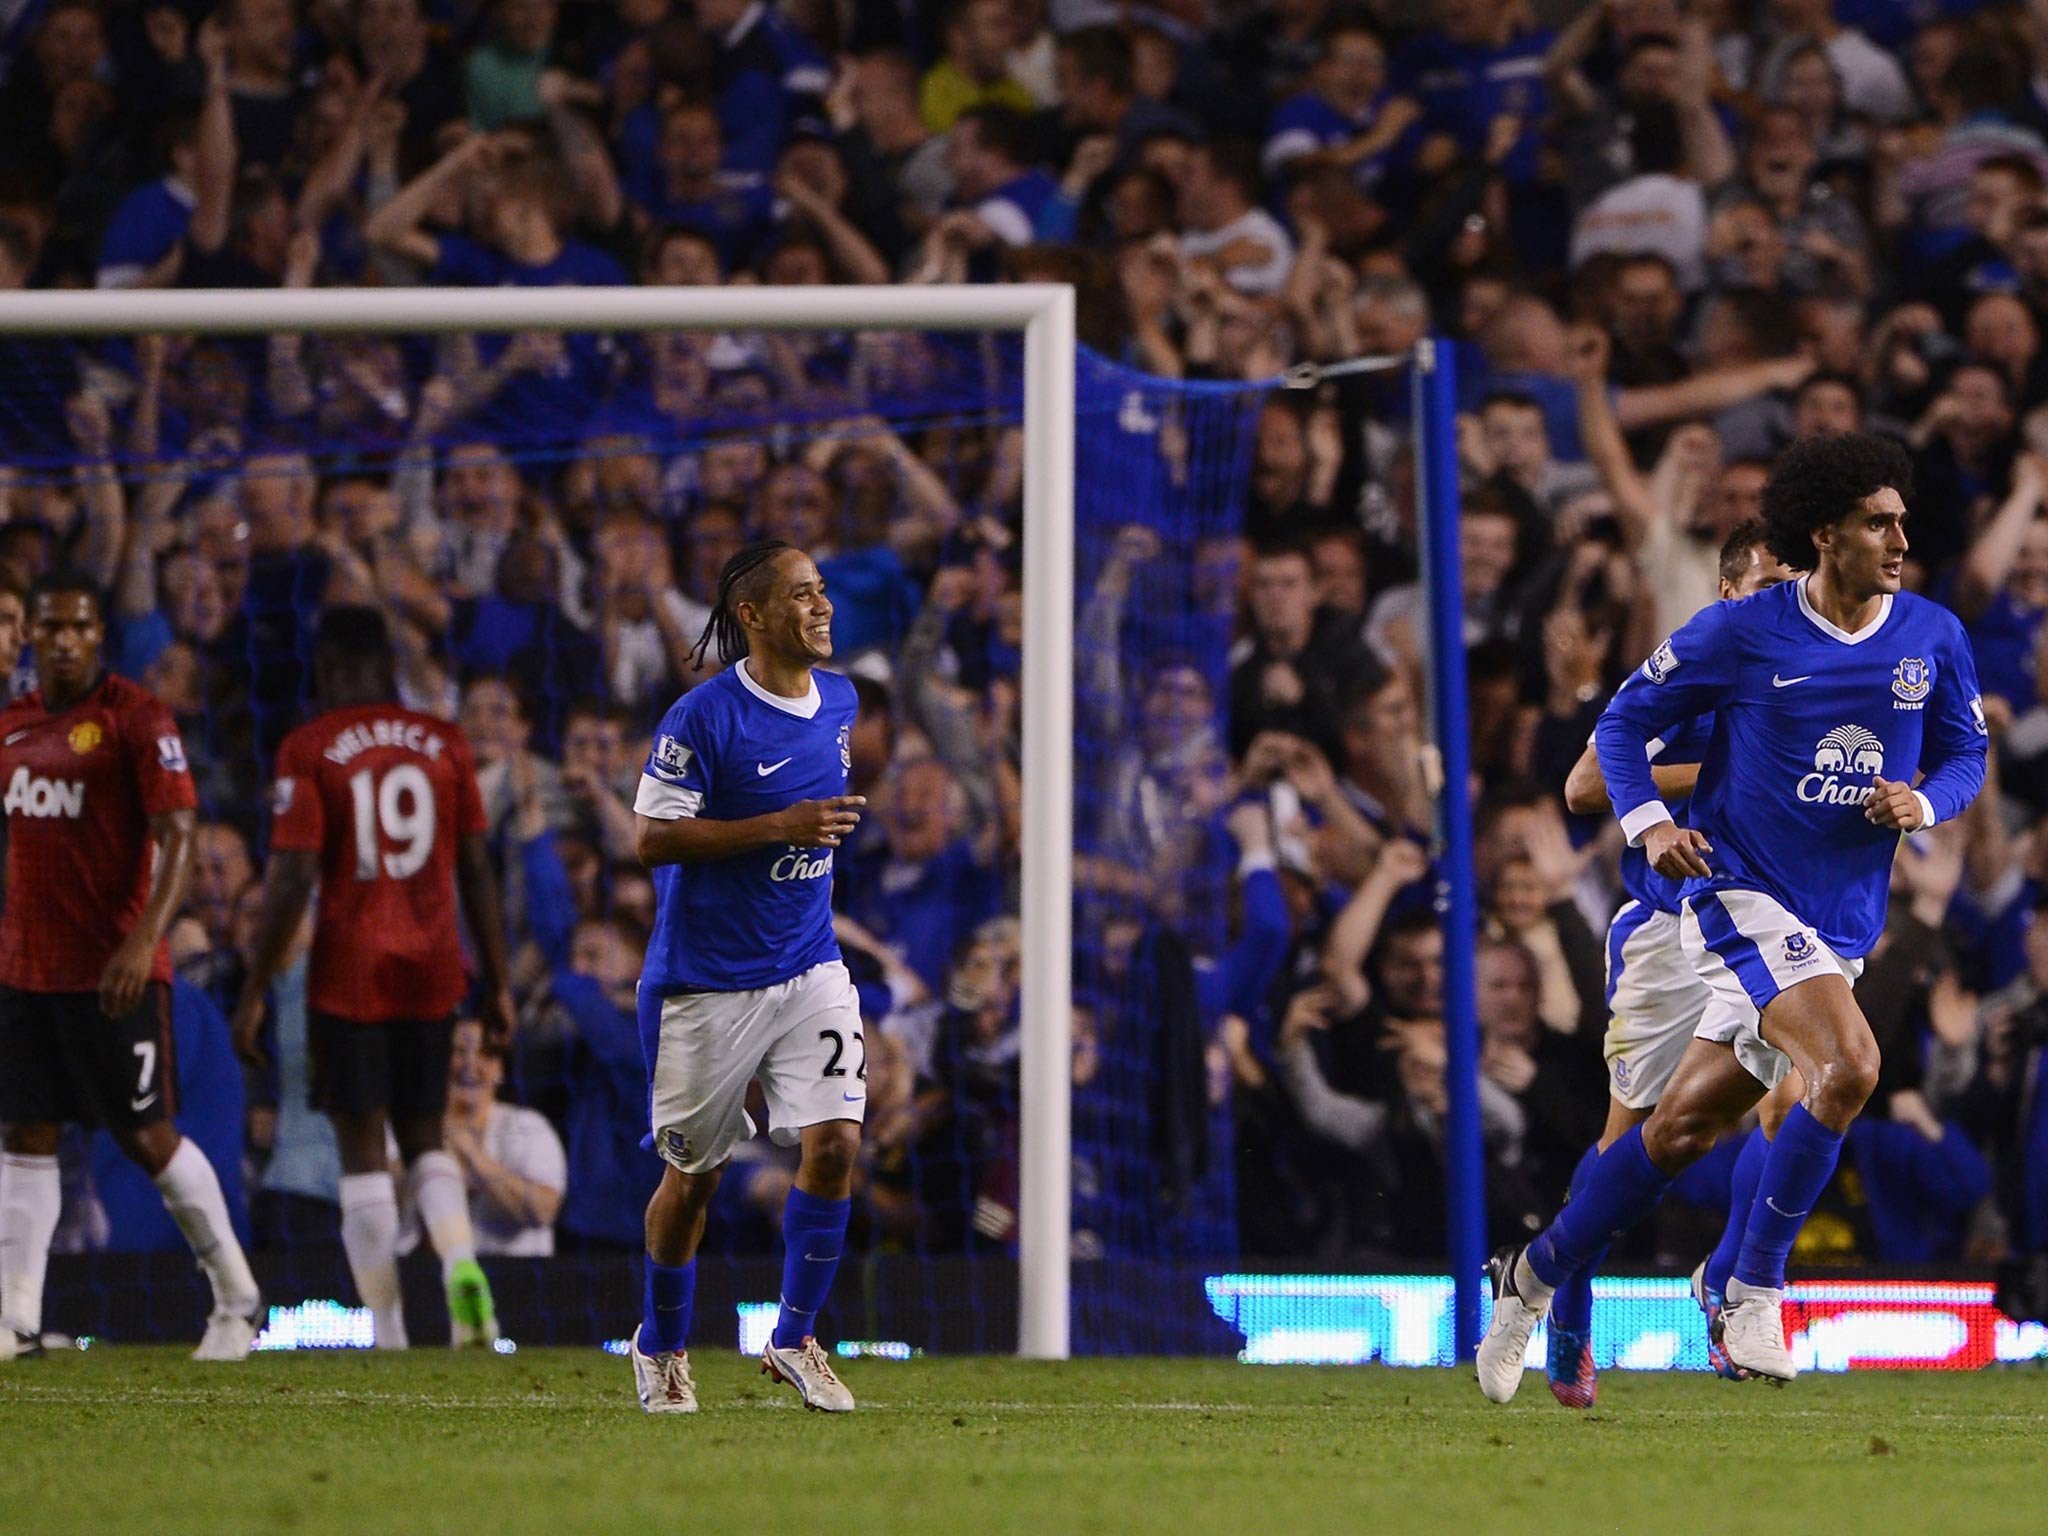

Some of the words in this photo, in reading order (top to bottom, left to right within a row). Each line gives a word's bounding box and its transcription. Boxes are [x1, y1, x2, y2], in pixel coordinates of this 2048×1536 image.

[323, 719, 444, 765] WELBECK
[1796, 772, 1877, 806] Chan
[350, 763, 436, 880] 19
[133, 1041, 156, 1094] 7
